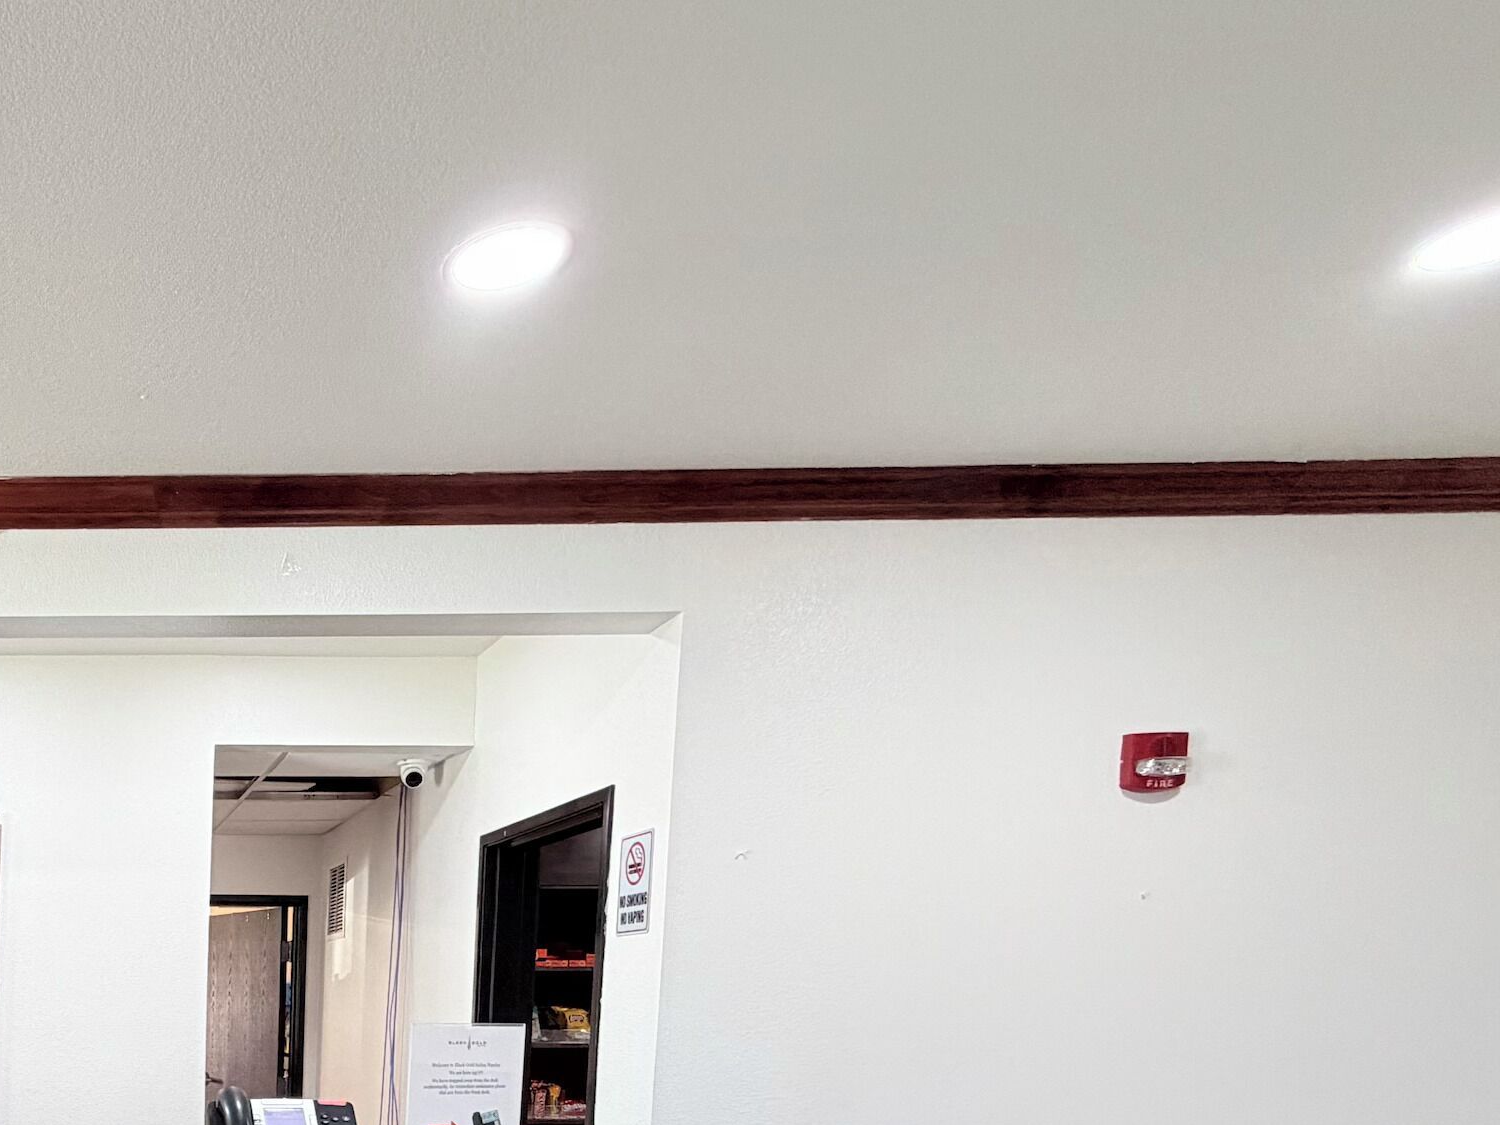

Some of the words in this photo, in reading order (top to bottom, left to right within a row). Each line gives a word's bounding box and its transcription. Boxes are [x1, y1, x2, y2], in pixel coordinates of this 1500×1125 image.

[1146, 779, 1174, 788] FIRE
[619, 896, 626, 908] NO
[626, 892, 647, 908] SMOKING
[620, 912, 627, 925] NO
[627, 910, 644, 925] VAPING
